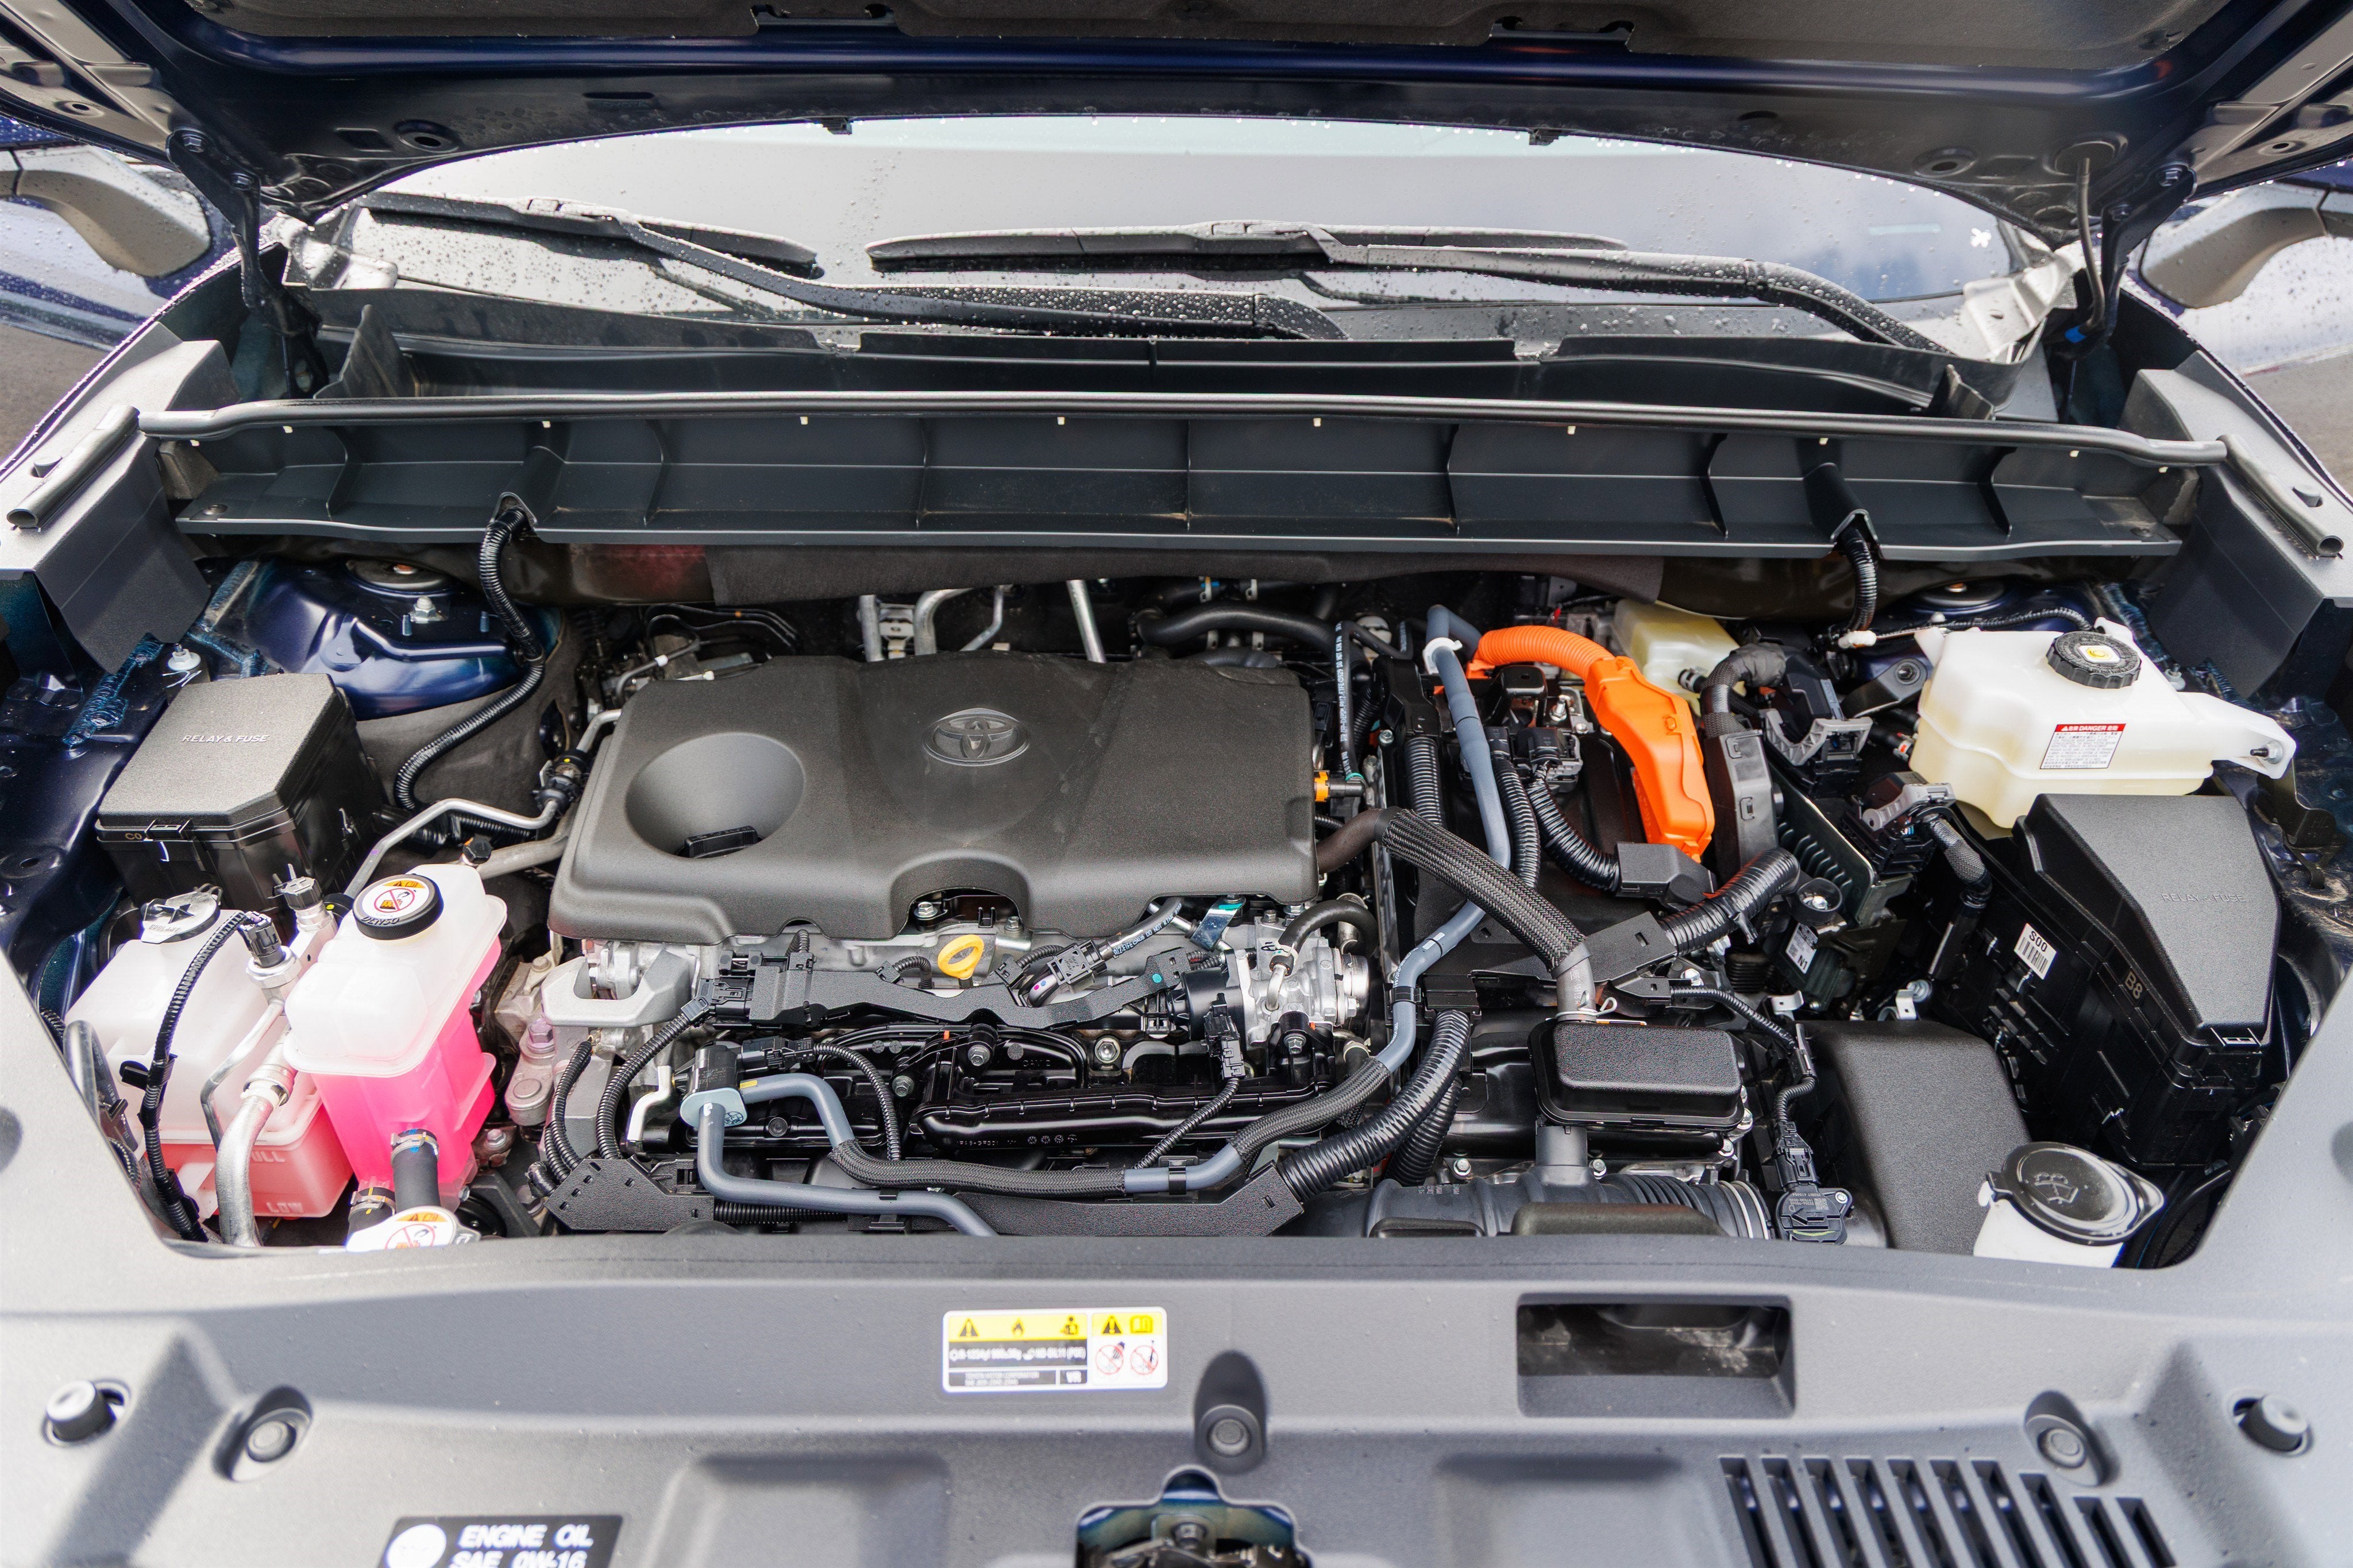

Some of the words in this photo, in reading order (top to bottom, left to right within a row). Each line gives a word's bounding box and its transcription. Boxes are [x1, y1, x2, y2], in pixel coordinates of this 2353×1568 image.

[182, 735, 225, 743] RELAY
[2161, 894, 2199, 902] RELAY
[2212, 894, 2246, 903] FUSE
[361, 916, 400, 925] DENSO
[1797, 955, 1808, 970] N1
[2124, 971, 2143, 999] B8
[250, 1151, 286, 1163] ULL
[266, 1202, 304, 1214] LOW
[457, 1524, 548, 1549] ENGINE
[555, 1523, 594, 1549] OIL
[449, 1550, 503, 1568] SAE
[510, 1550, 588, 1568] 0W-16
